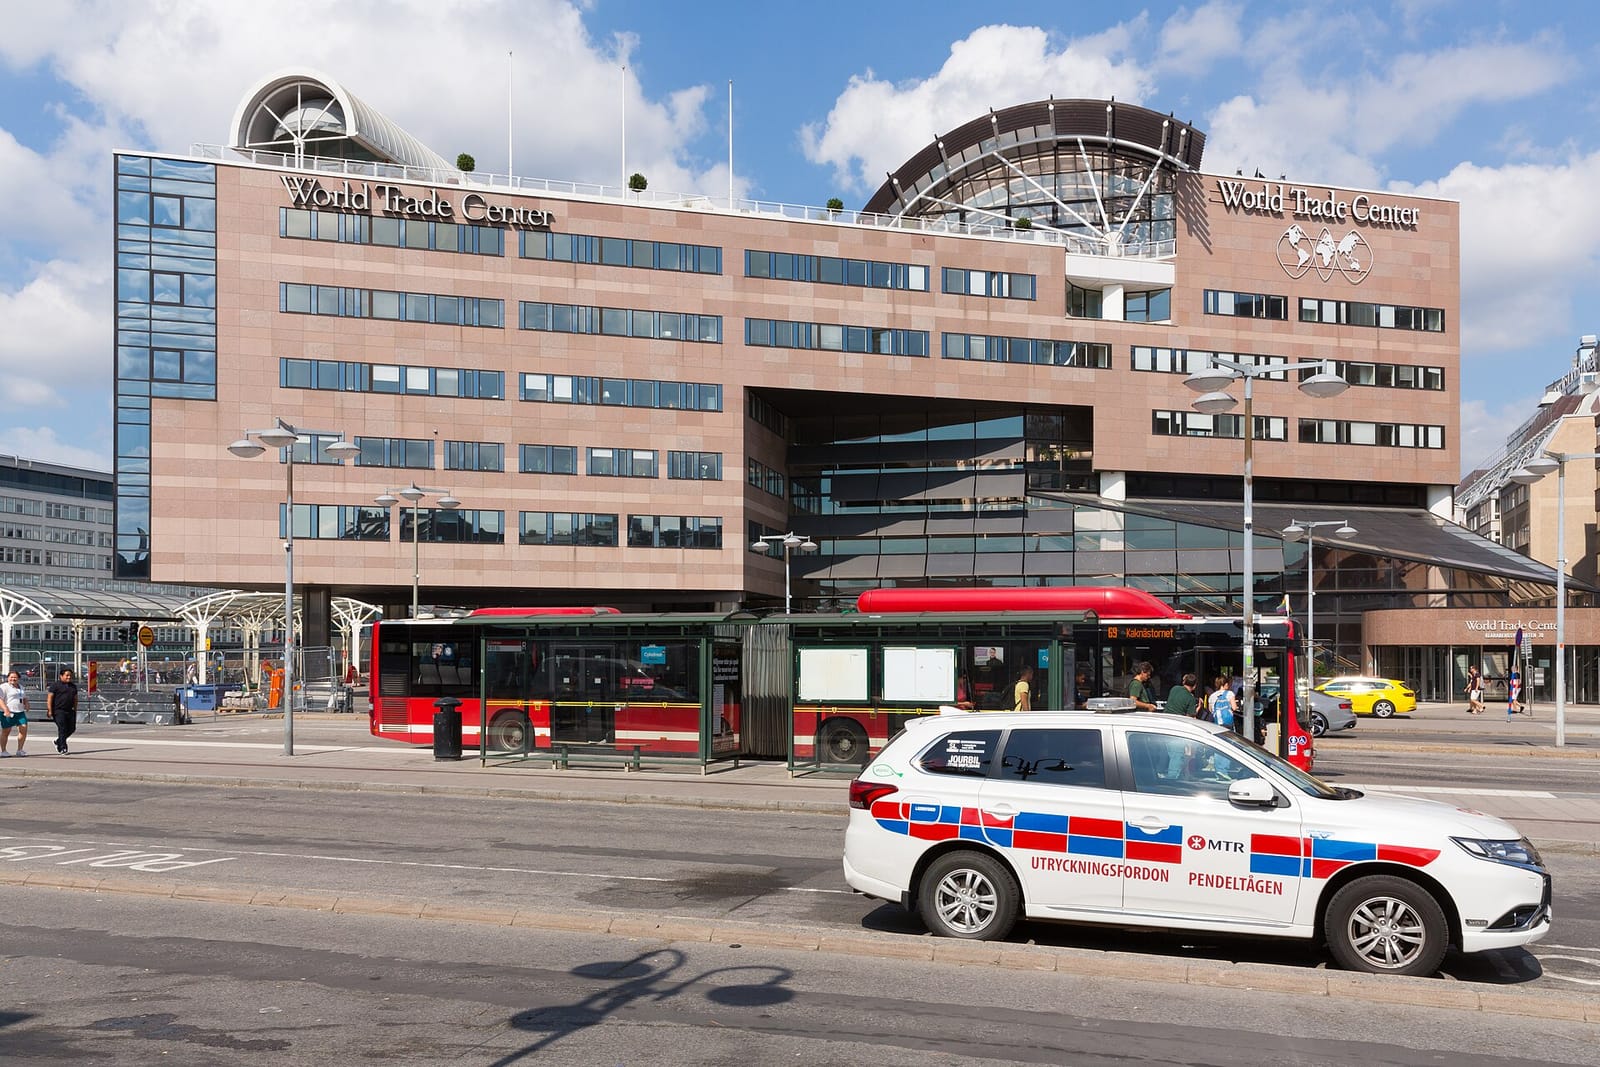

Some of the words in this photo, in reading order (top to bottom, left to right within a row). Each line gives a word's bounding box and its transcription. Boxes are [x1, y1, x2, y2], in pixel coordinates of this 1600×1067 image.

[280, 175, 369, 210] World
[375, 184, 451, 217] Trade
[461, 193, 552, 227] Center
[1218, 180, 1284, 213] World
[1290, 187, 1347, 218] Trade
[1352, 195, 1420, 225] Center
[1107, 626, 1118, 639] 69
[1126, 627, 1174, 638] Kaknästornet
[1465, 620, 1497, 630] World
[1497, 620, 1527, 630] Trade
[1528, 620, 1558, 631] Cente
[947, 754, 979, 764] JOURBIL
[1208, 839, 1245, 853] MTR
[1031, 856, 1169, 883] UTRYCKNINGSFORDON
[1188, 872, 1283, 896] PENDELTÅGEN
